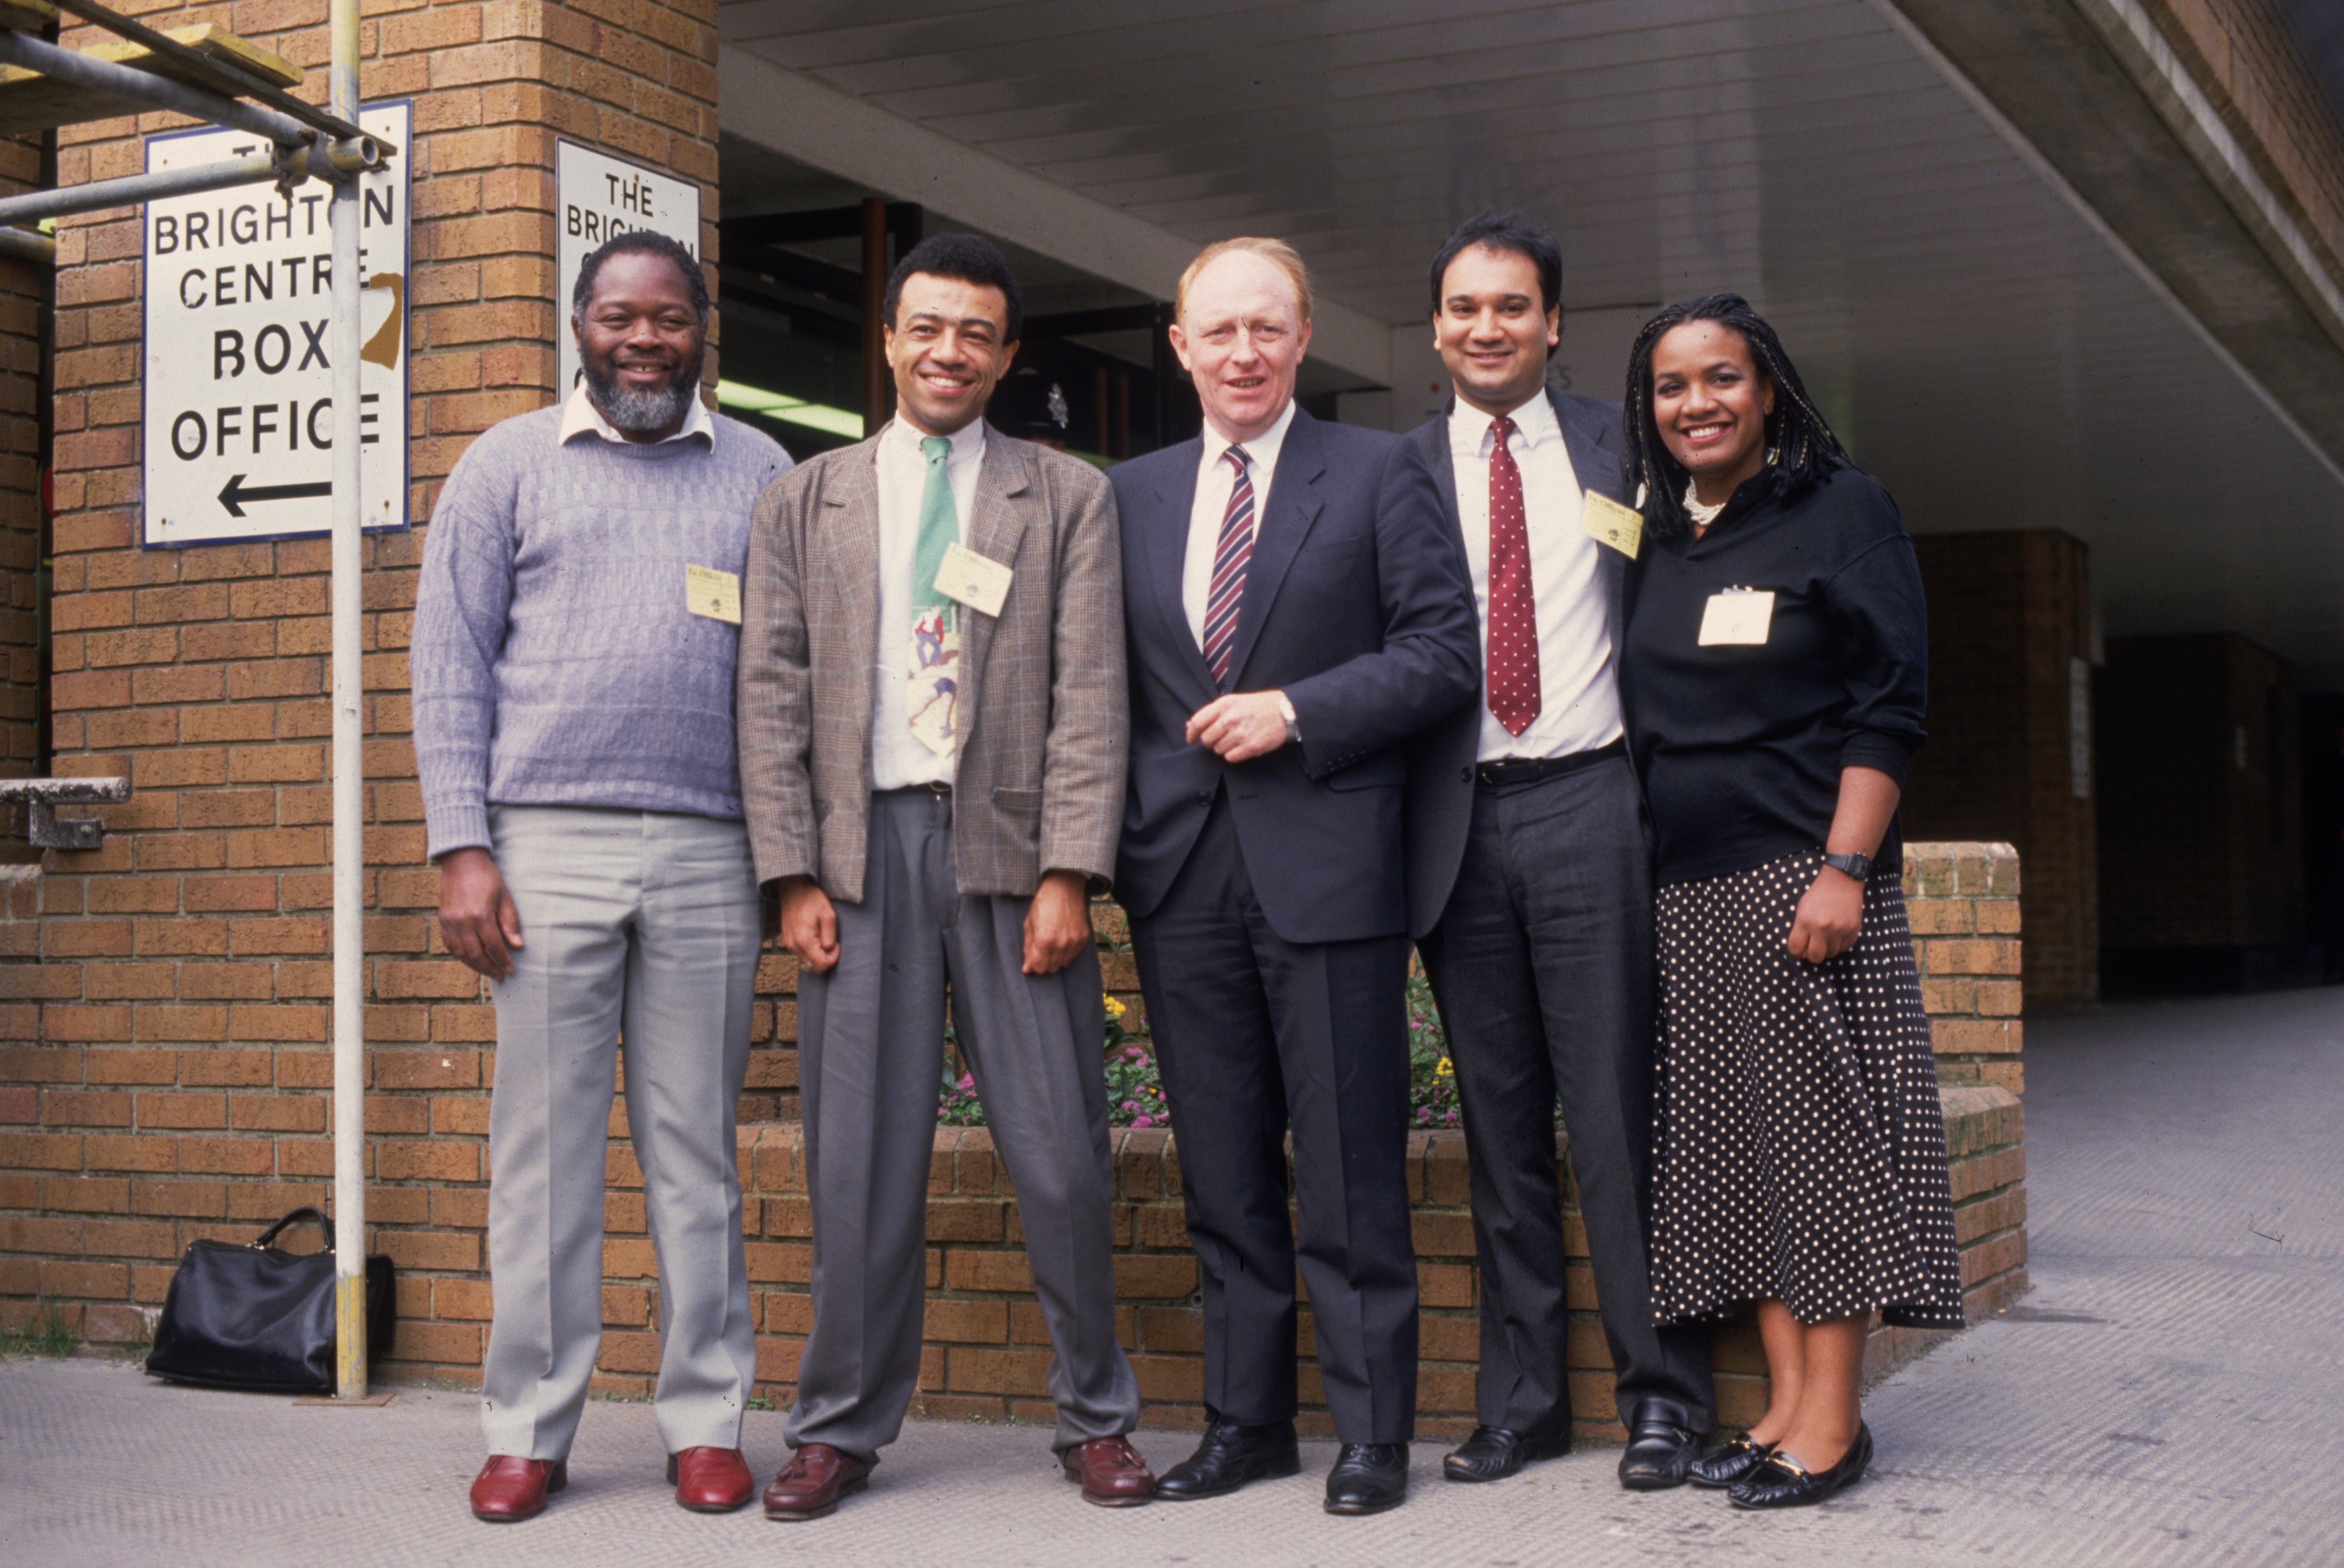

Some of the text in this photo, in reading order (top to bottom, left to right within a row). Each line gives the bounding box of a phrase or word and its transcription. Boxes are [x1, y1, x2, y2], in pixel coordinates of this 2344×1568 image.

[155, 185, 393, 255] BRIGHTN
[605, 173, 653, 217] THE
[214, 319, 332, 380] BOX
[171, 393, 379, 461] OFFICE
